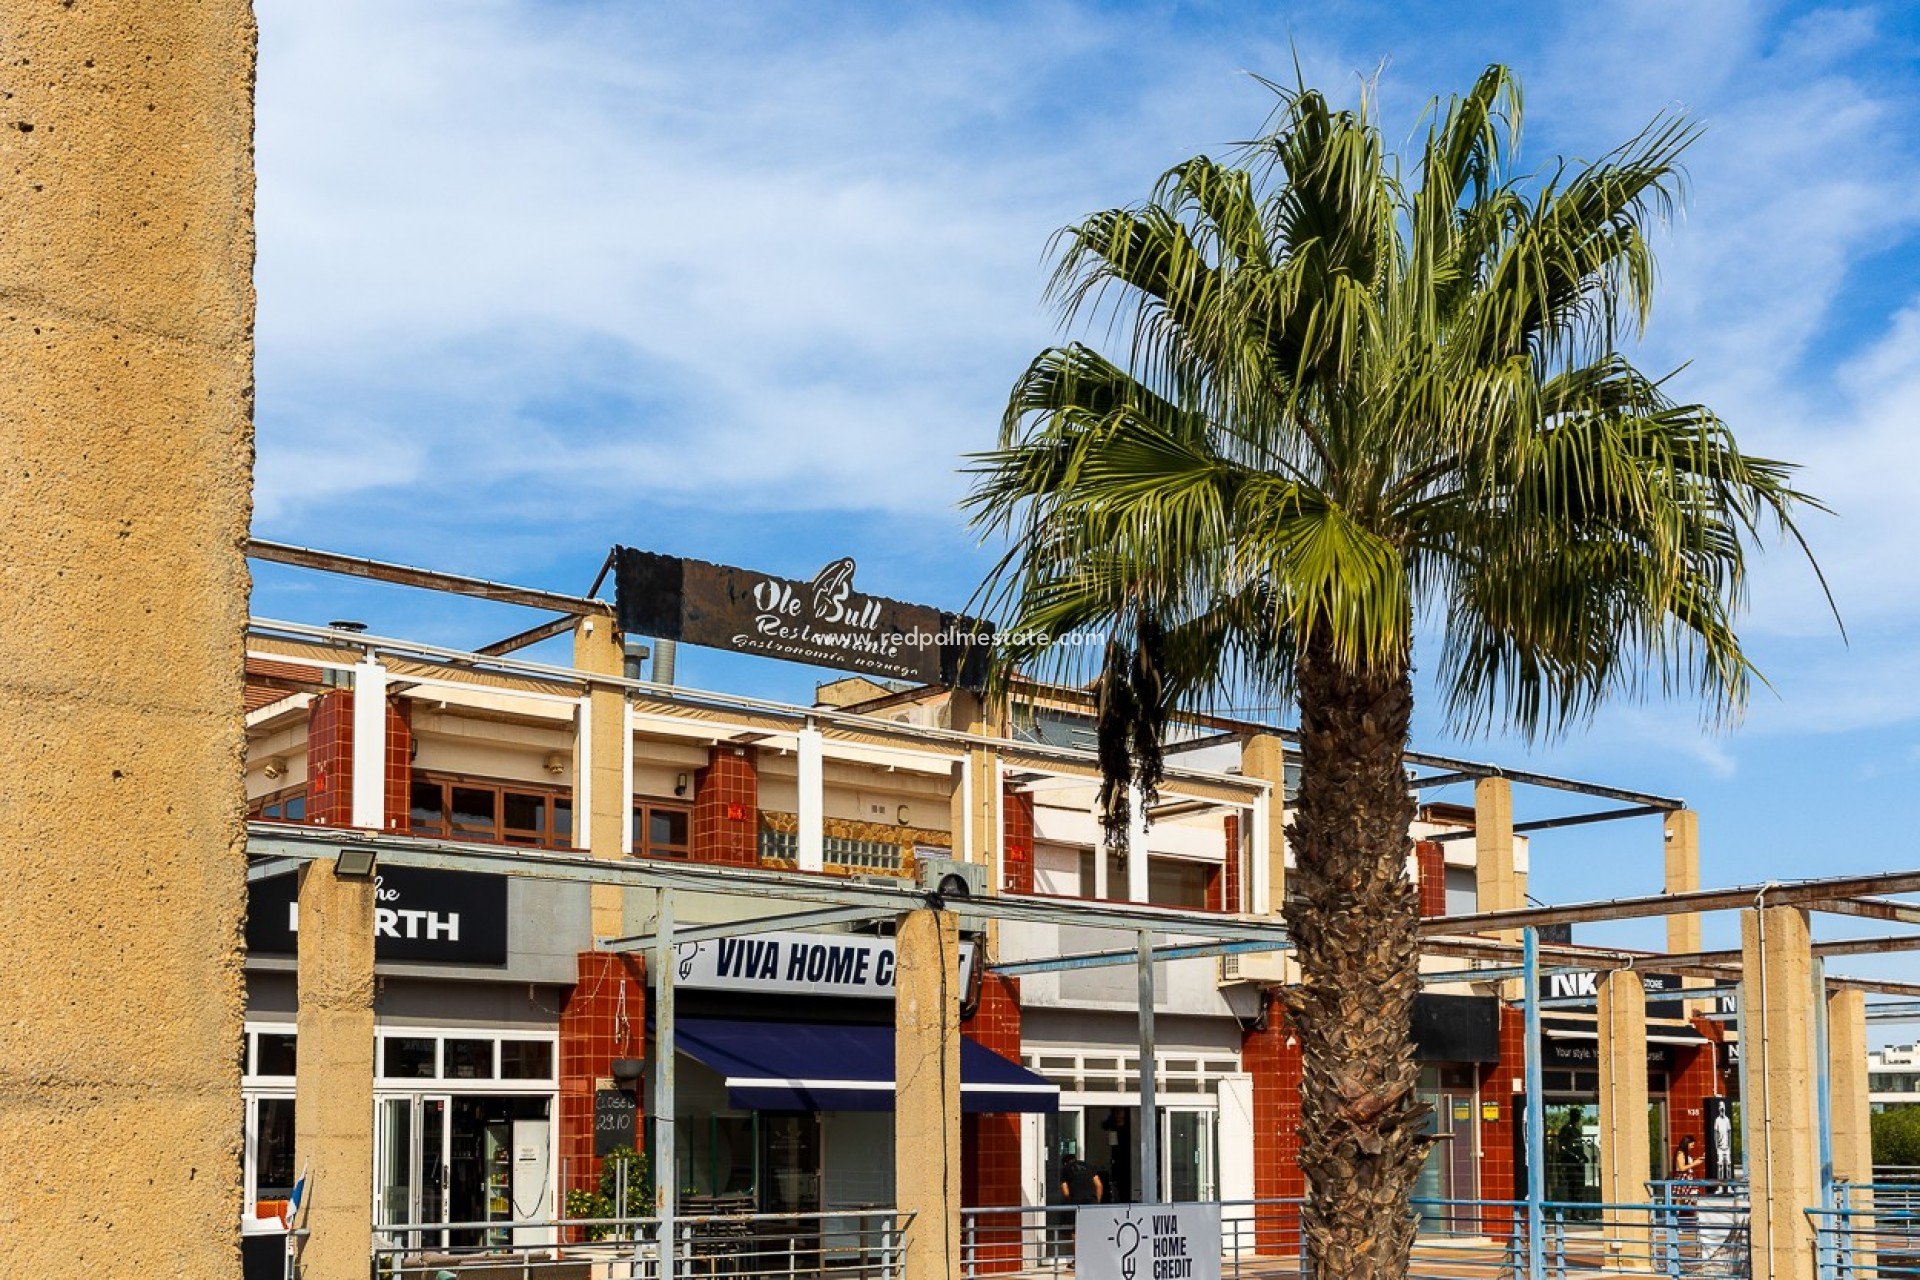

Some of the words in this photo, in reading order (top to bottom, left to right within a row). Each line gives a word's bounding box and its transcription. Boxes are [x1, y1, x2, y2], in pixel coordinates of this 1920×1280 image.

[753, 578, 802, 617] Ole
[813, 581, 883, 631] Bull
[375, 875, 401, 901] he
[289, 901, 460, 942] RTH
[716, 937, 780, 980] VIVA
[786, 943, 871, 986] HOME
[1555, 1047, 1573, 1059] Your
[1152, 1215, 1178, 1235] VIVA
[1153, 1236, 1187, 1258] HOME
[1153, 1258, 1192, 1279] CREDIT
